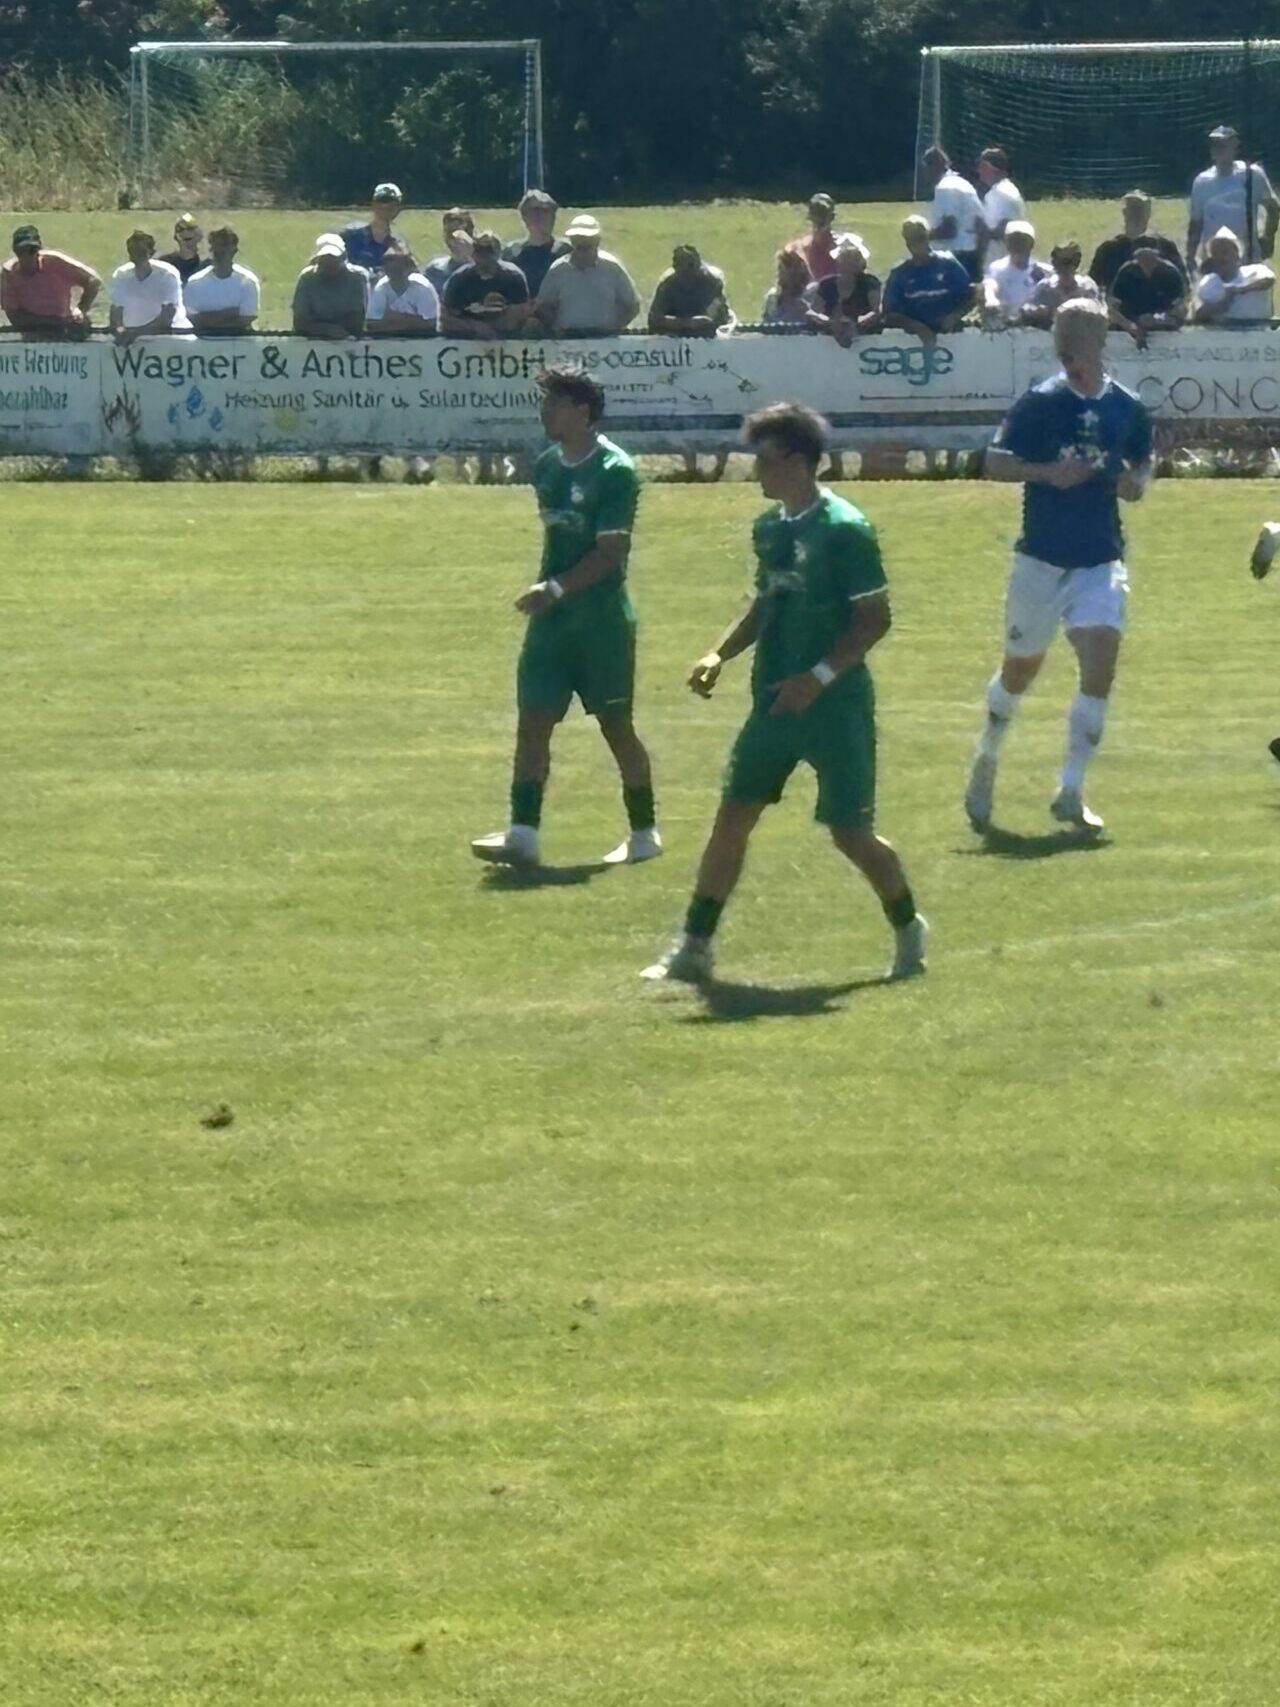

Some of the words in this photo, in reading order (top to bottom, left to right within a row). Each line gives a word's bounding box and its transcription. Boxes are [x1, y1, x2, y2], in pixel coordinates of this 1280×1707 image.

[112, 346, 246, 387] Wagner
[260, 345, 290, 379] &
[301, 344, 423, 379] Anthes
[437, 346, 546, 379] GmbH
[859, 345, 954, 386] sage
[224, 390, 306, 412] Heizung
